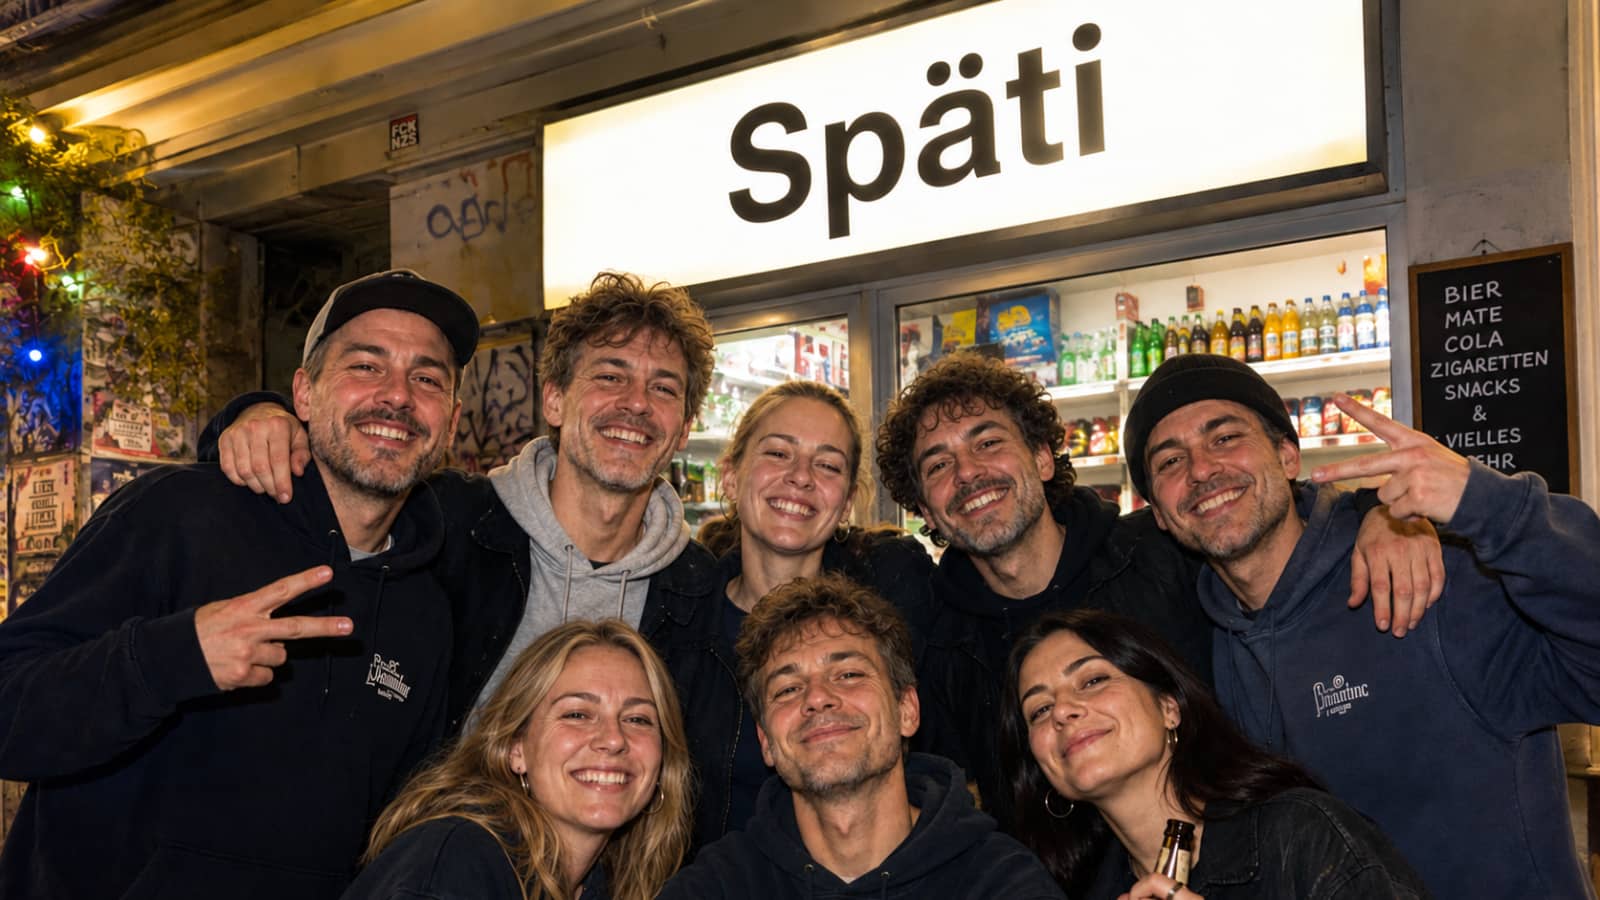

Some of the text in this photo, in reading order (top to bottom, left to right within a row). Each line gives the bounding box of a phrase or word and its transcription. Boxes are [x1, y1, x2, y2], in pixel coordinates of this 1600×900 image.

[391, 119, 417, 138] FCK
[728, 22, 1107, 240] Späti
[391, 132, 417, 150] NZS
[1444, 280, 1502, 304] BIER
[1444, 305, 1502, 329] MATE
[1444, 330, 1504, 353] COLA
[1430, 349, 1549, 378] ZIGARETTEN
[1444, 377, 1521, 401] SNACKS
[1472, 404, 1487, 422] &
[1445, 426, 1522, 449] VIELLES
